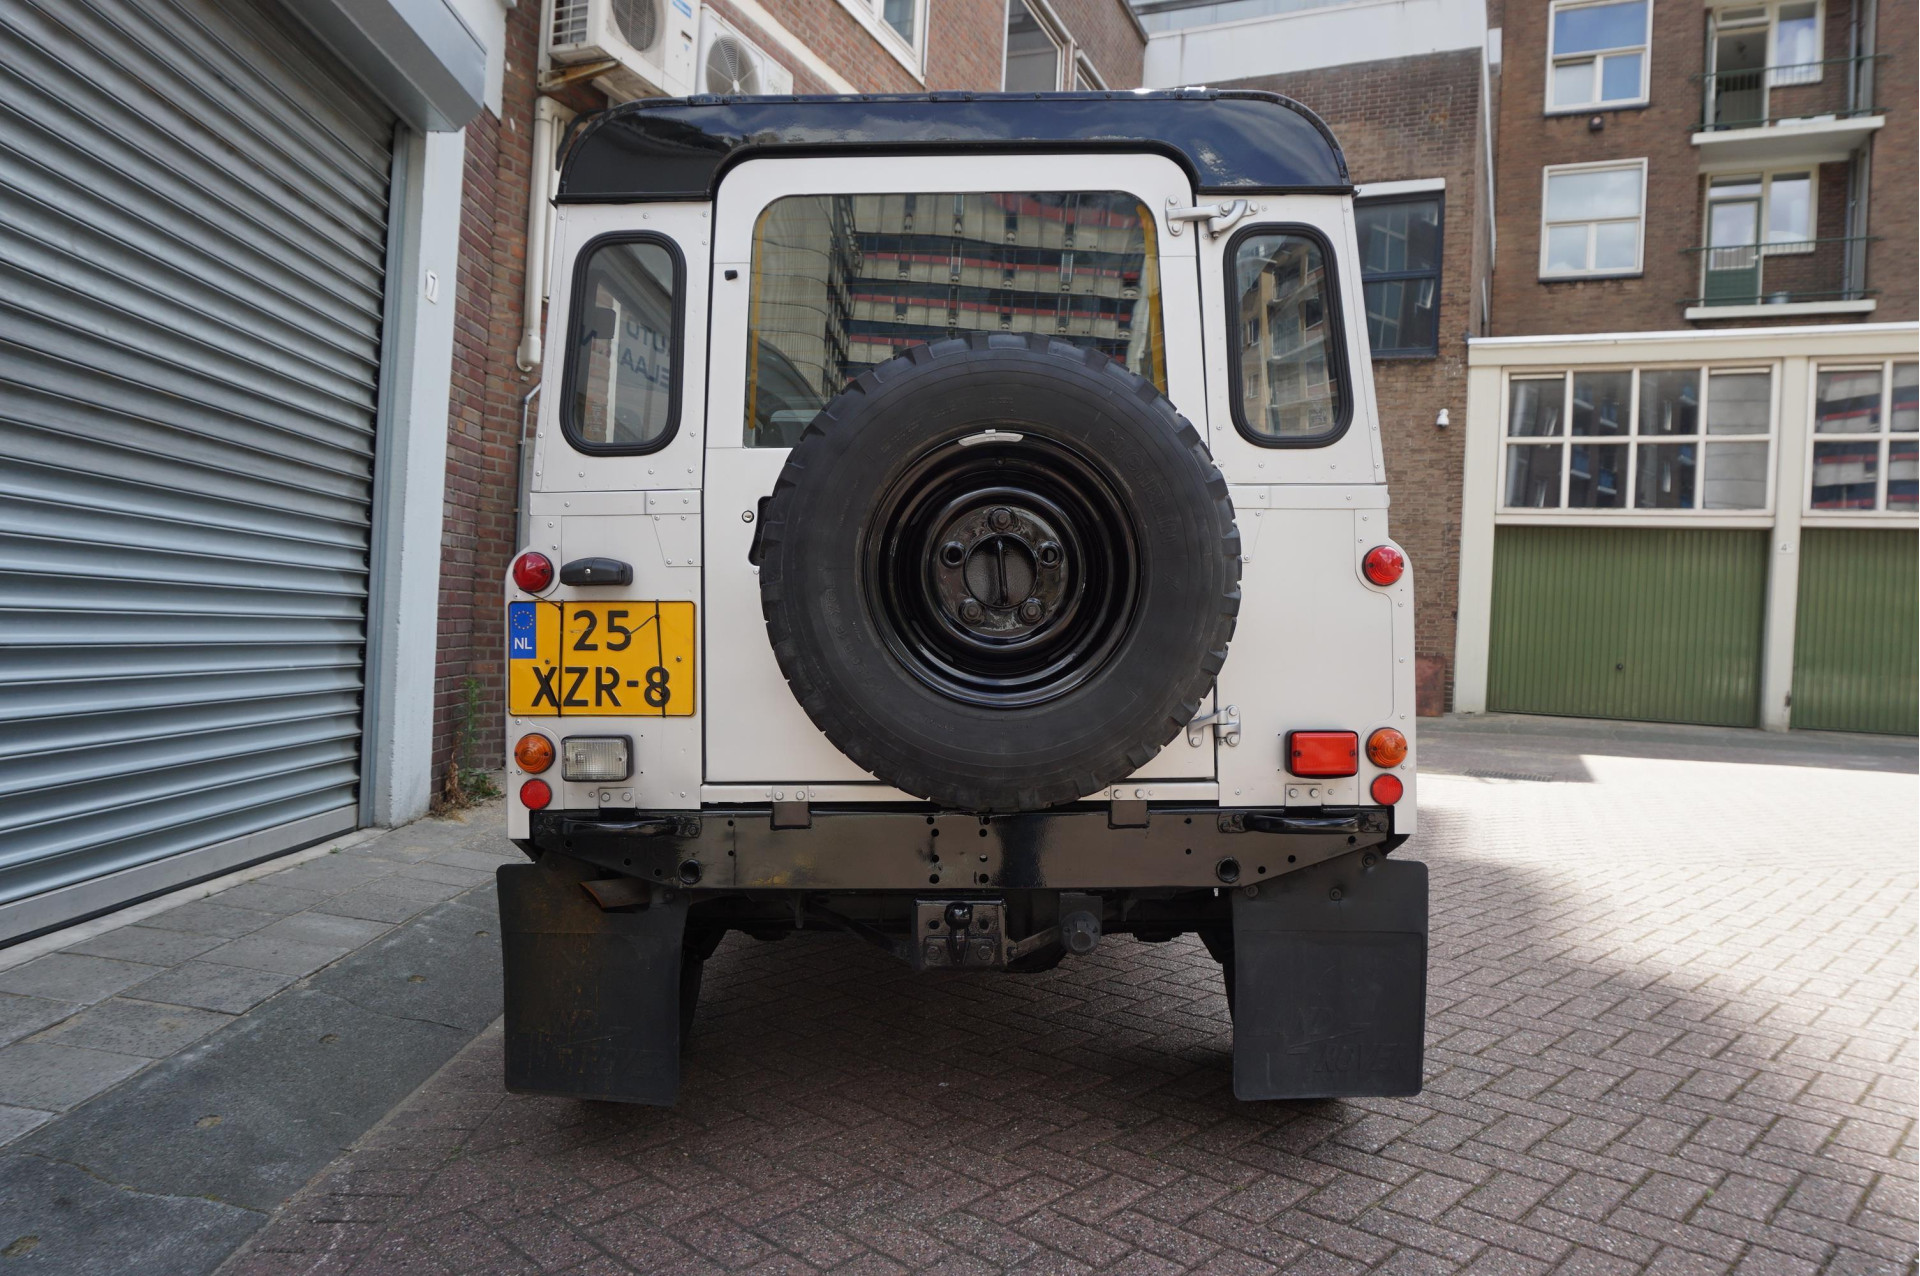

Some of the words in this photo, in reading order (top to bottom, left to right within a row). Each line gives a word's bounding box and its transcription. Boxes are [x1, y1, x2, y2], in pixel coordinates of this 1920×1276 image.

[514, 637, 533, 650] NL
[573, 610, 632, 651] 25
[531, 666, 671, 708] XZR-8
